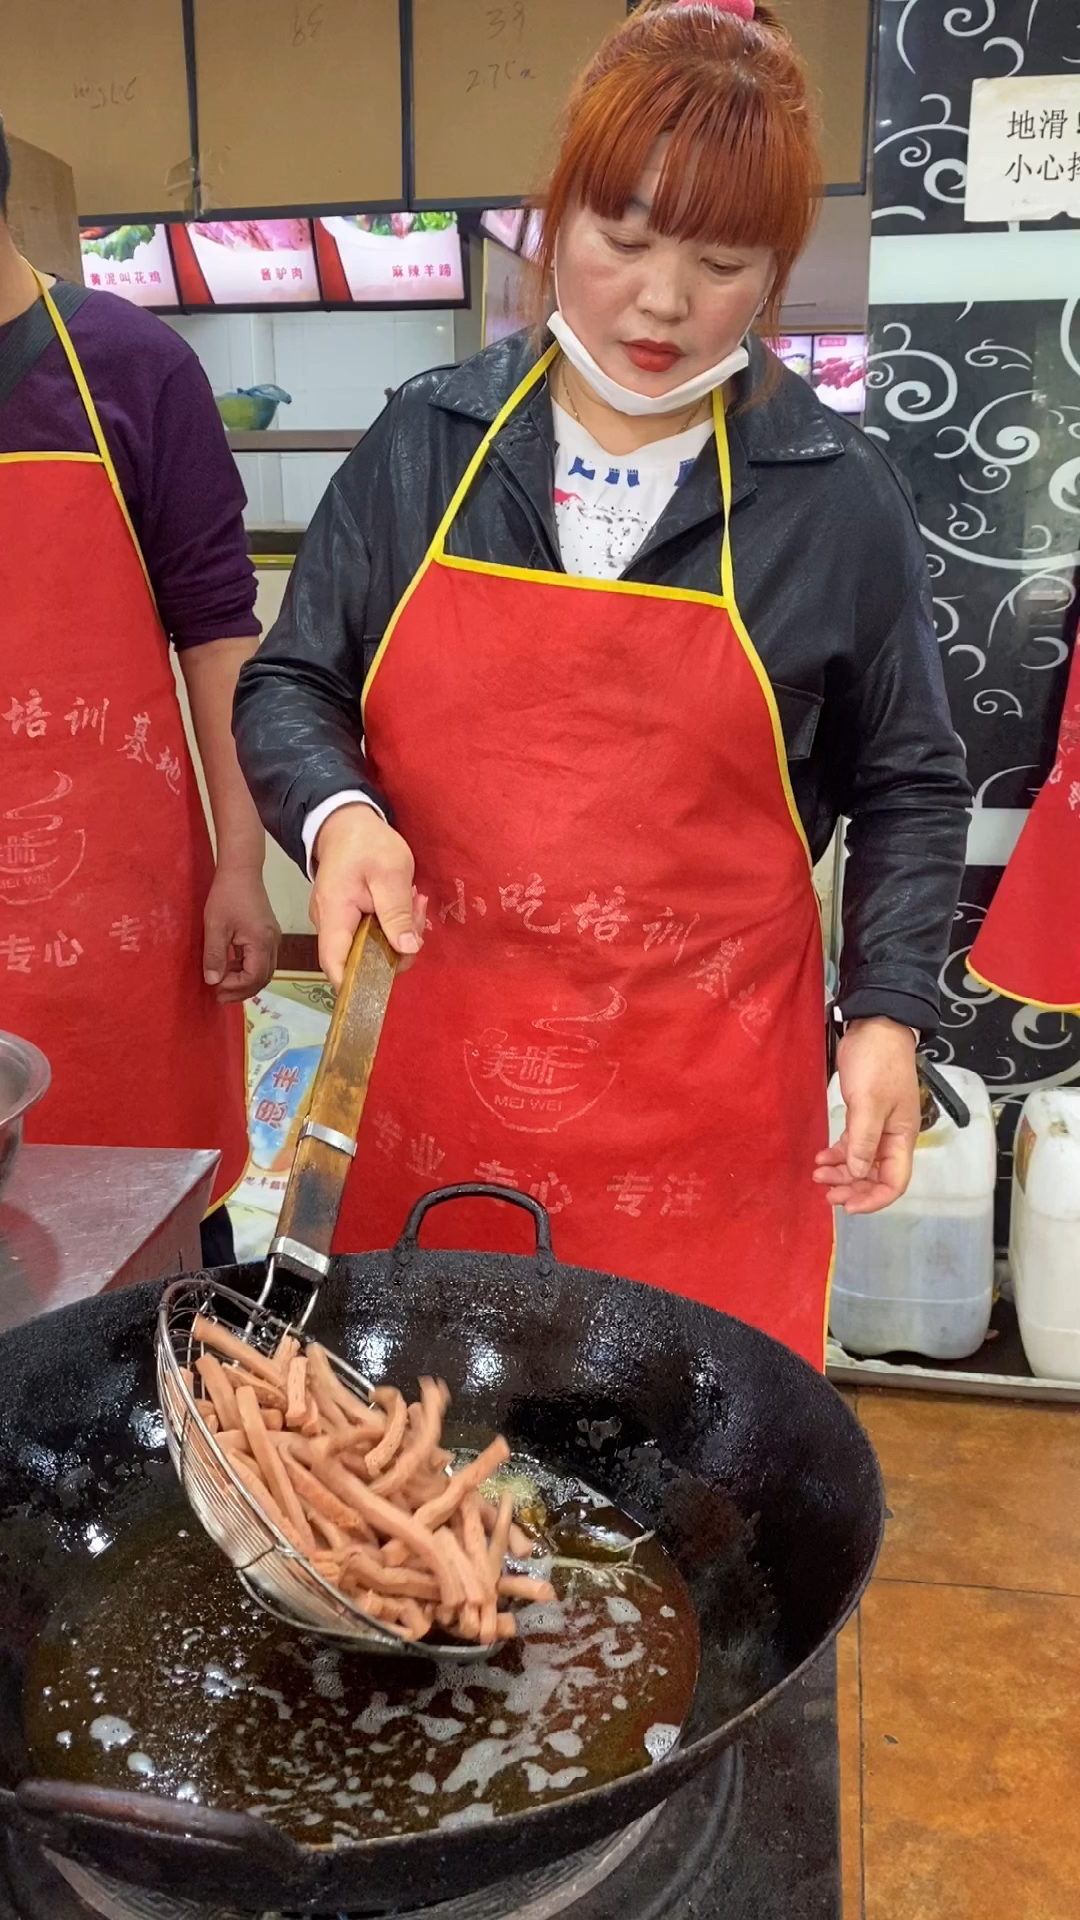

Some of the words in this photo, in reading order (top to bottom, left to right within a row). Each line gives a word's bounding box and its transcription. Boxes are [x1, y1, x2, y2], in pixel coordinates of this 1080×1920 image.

[90, 270, 162, 286] 黄泥叫花鸡
[260, 265, 303, 281] 酱驴肉
[391, 263, 452, 278] 麻辣羊蹄
[2, 688, 182, 795] 培训基地
[0, 930, 84, 974] 专心
[423, 872, 772, 1045] 小吃培训基地
[494, 1094, 525, 1109] MEI
[530, 1099, 562, 1112] WEI
[474, 1158, 573, 1214] 专心
[606, 1170, 706, 1218] 专注
